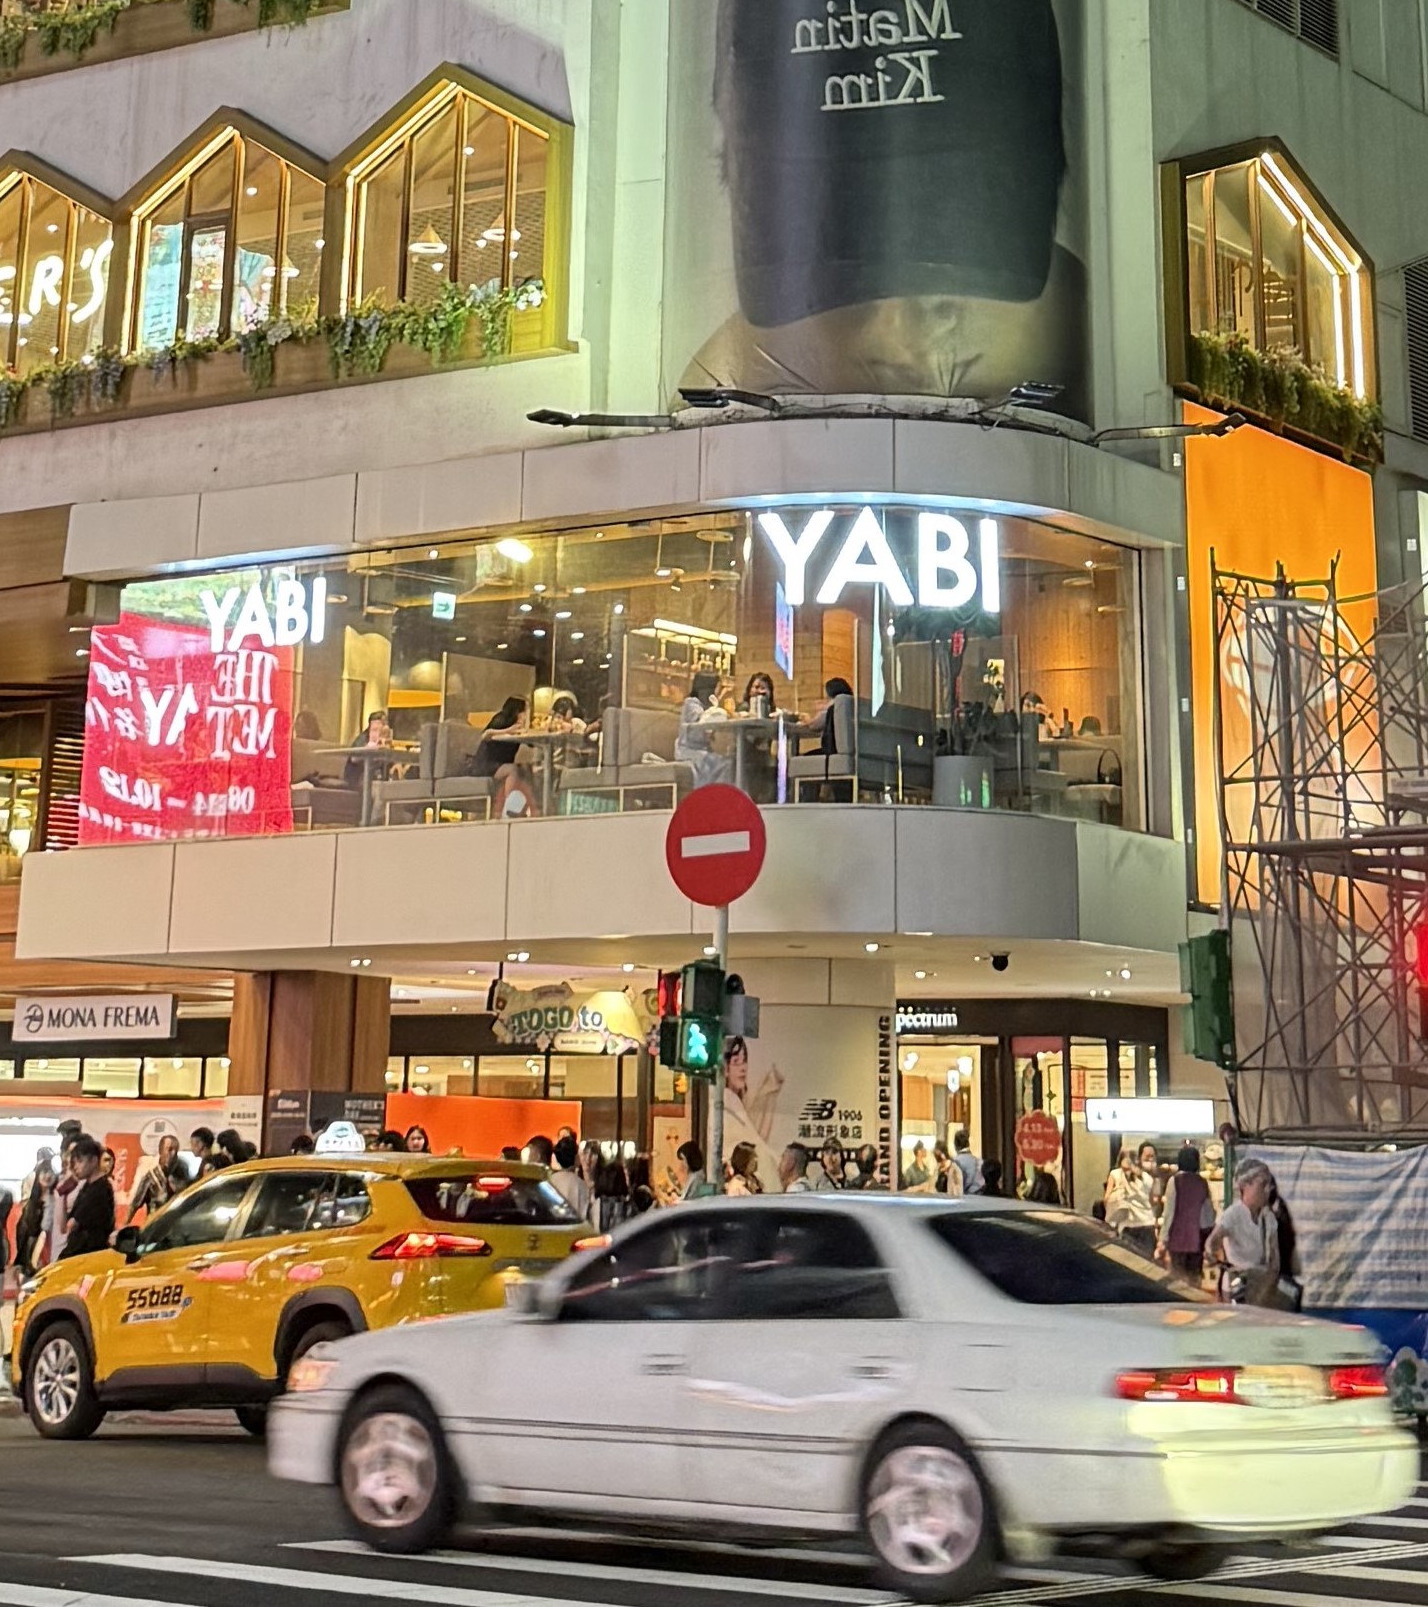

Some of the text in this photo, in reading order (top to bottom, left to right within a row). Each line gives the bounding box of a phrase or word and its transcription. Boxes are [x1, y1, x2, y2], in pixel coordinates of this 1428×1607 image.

[758, 505, 1000, 613] YABI
[199, 576, 327, 653] YABI
[47, 1005, 160, 1029] MONA FREMA
[510, 1005, 573, 1036] TOGO
[895, 1012, 959, 1032] pectrum
[879, 1015, 891, 1120] OPENING
